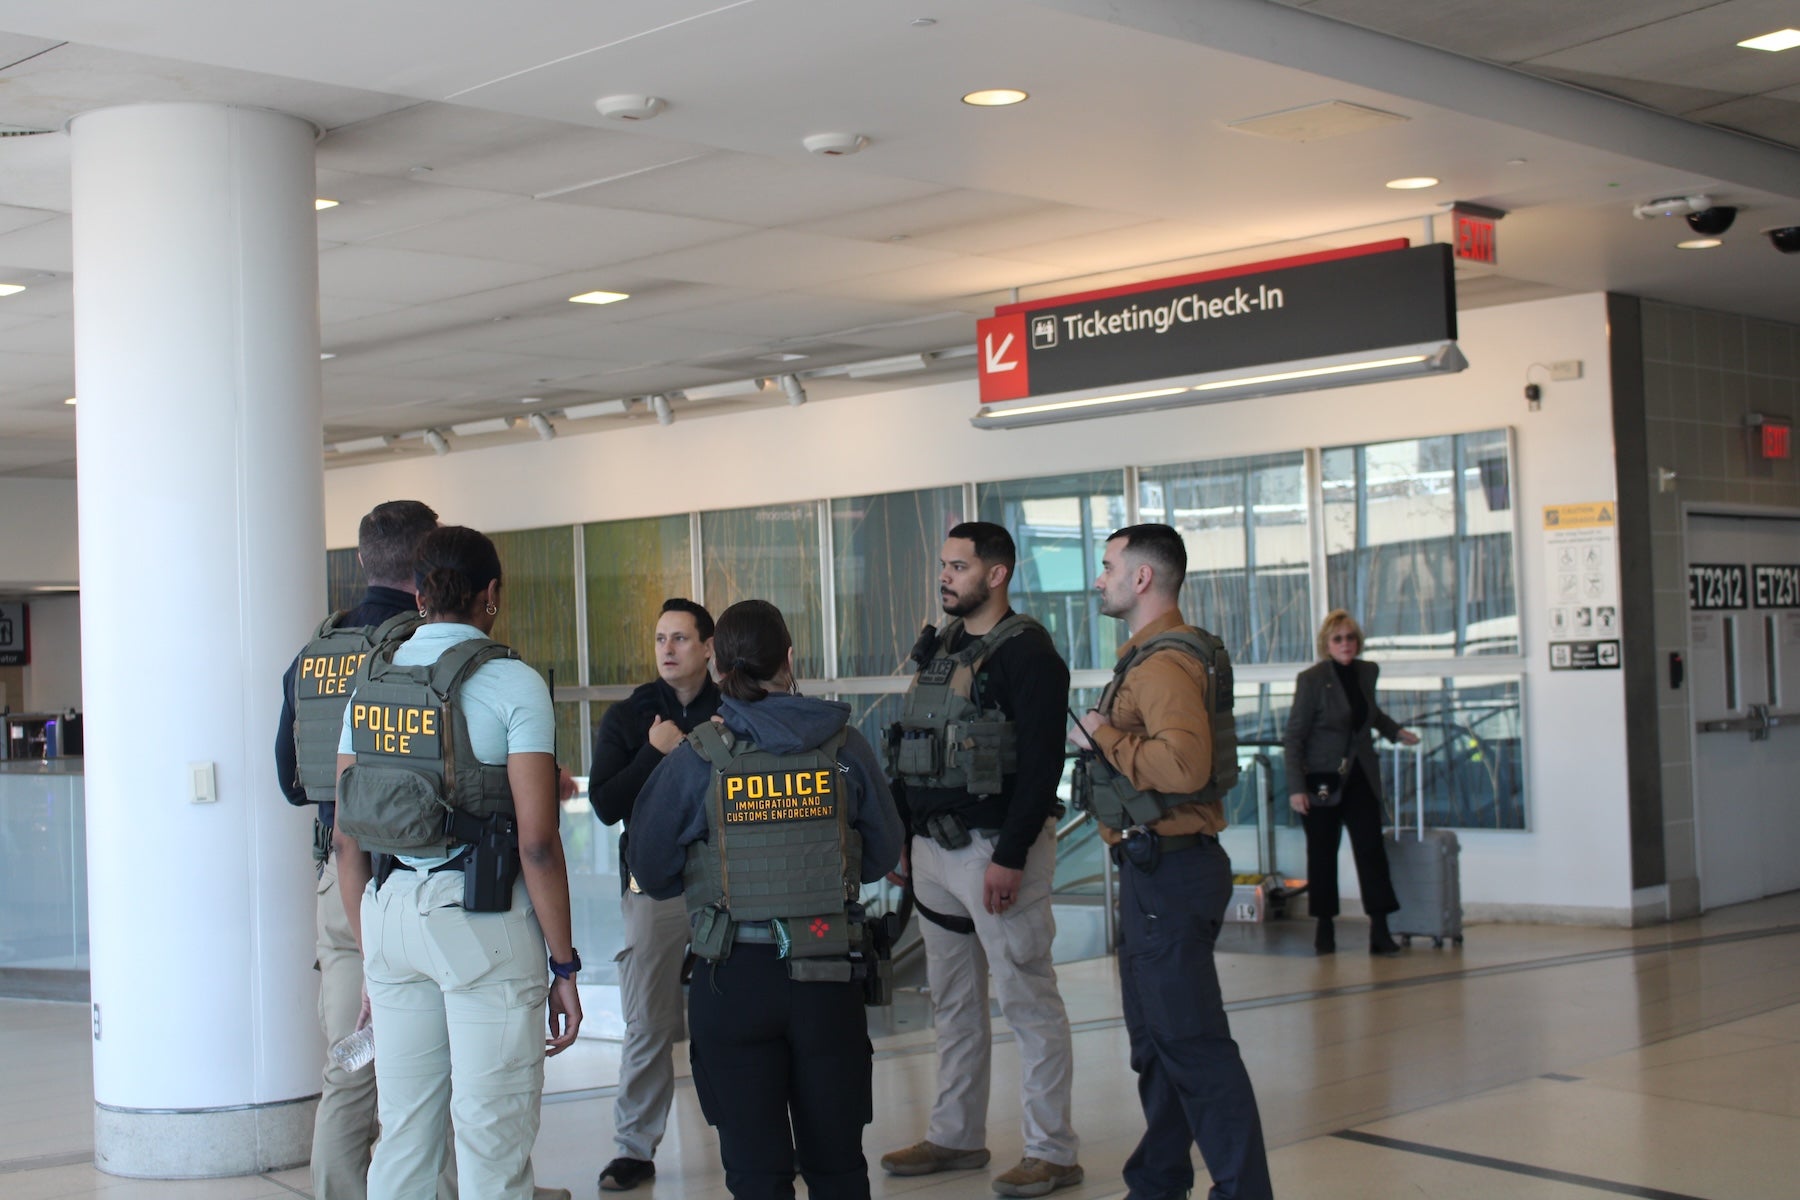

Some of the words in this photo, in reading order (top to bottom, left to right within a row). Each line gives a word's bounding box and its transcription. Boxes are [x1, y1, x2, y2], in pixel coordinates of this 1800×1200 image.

[1459, 217, 1493, 263] EXIT
[1063, 285, 1284, 341] Ticketing/Check-In
[1766, 425, 1788, 457] EXIT
[0, 655, 17, 663] ator
[318, 677, 347, 695] ICE
[354, 704, 436, 735] POLICE
[374, 732, 411, 754] ICE
[727, 771, 831, 799] POLICE
[726, 810, 768, 822] CUSTOMS
[771, 805, 833, 820] ENFORCEMENT
[735, 798, 798, 810] IMMIGRATION
[801, 796, 821, 806] AND
